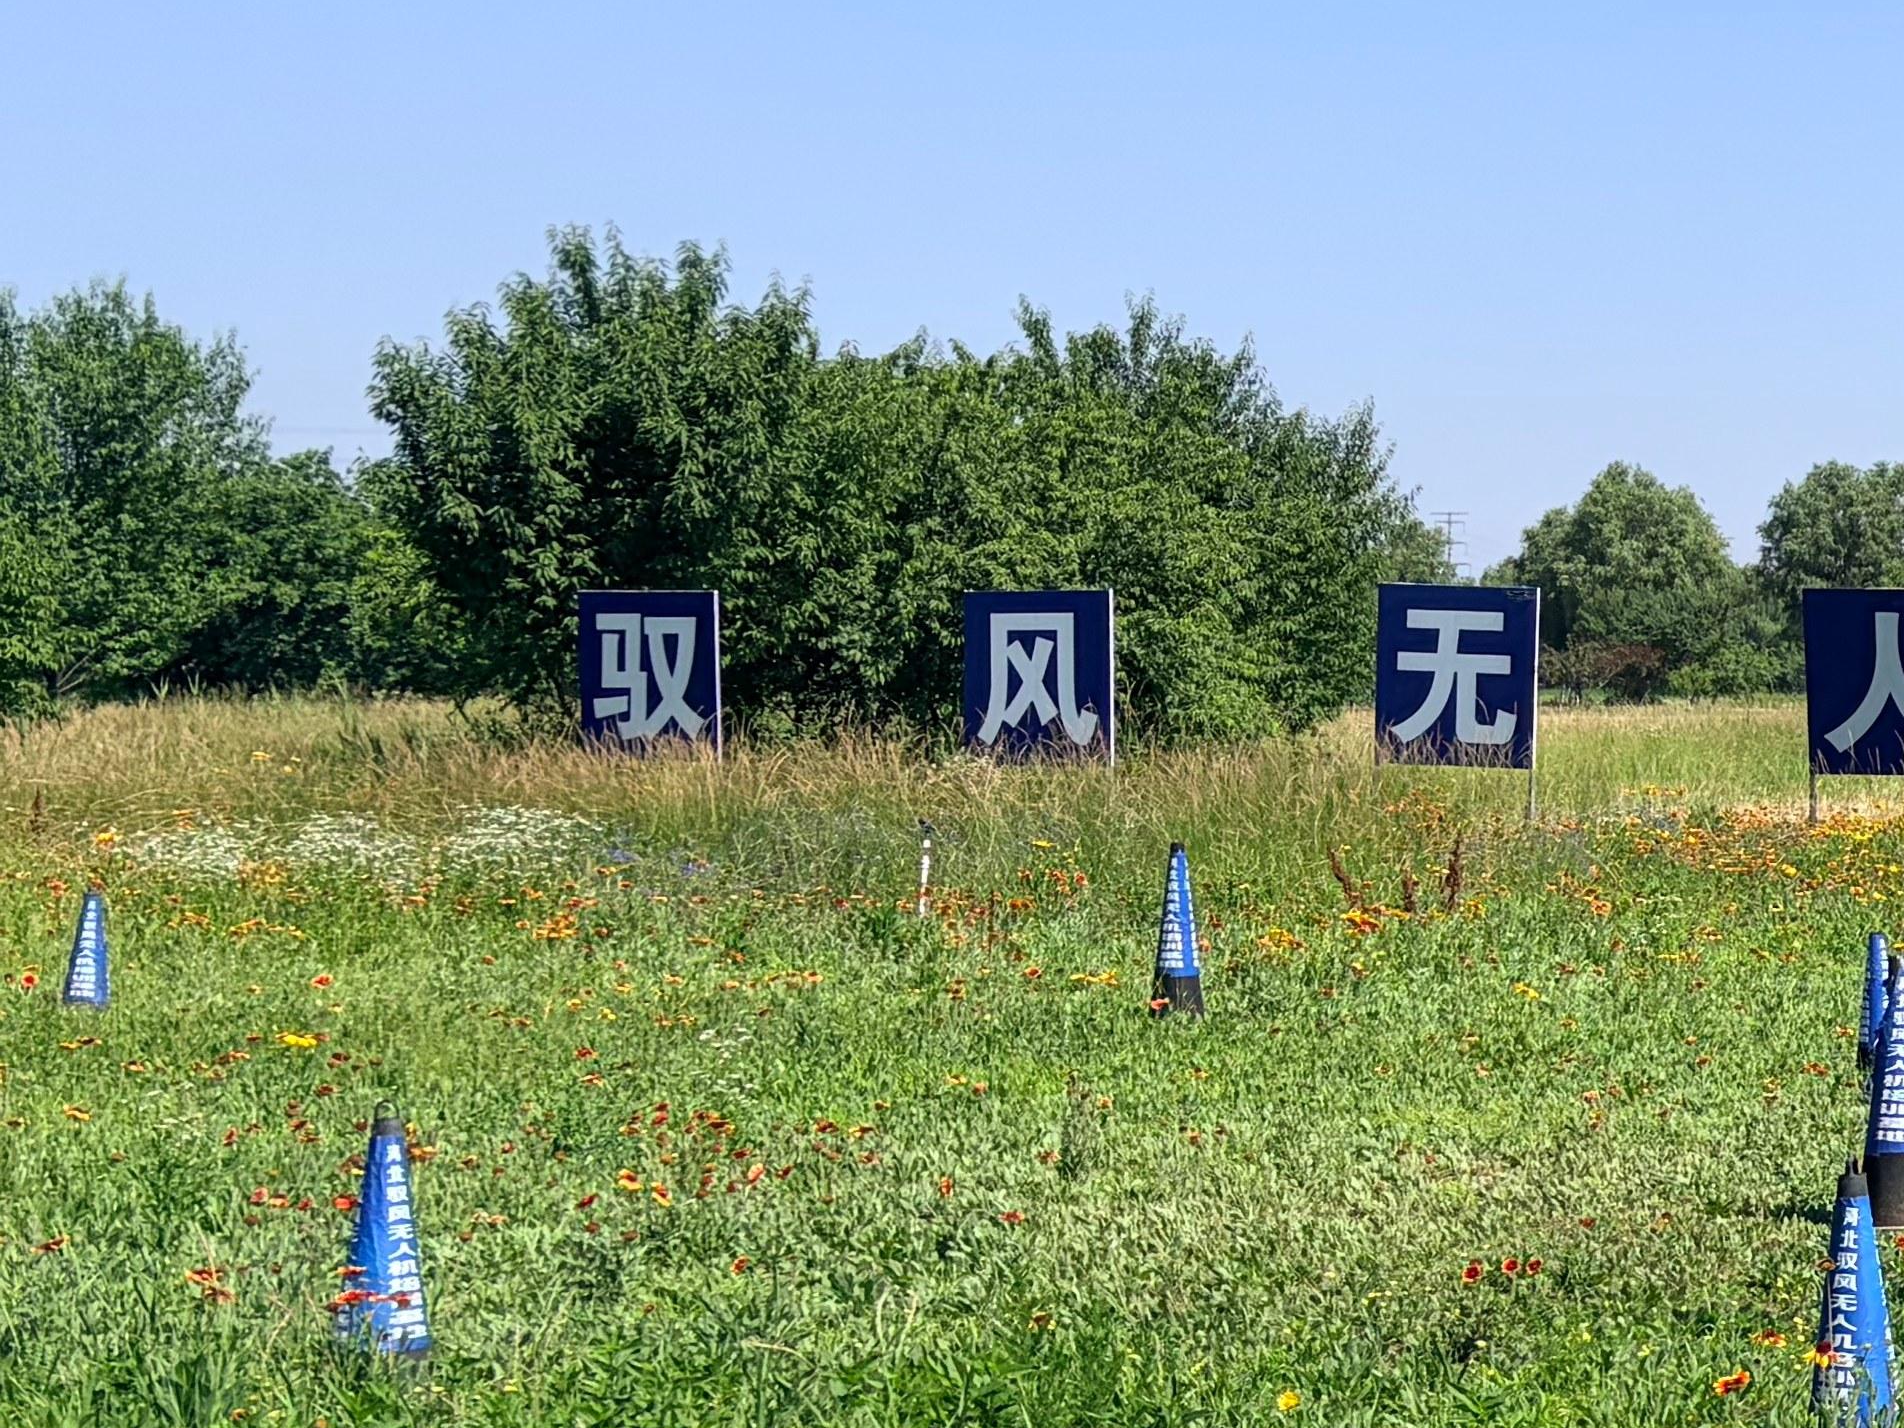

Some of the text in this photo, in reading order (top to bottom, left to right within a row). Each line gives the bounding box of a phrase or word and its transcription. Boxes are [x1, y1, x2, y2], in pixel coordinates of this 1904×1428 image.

[594, 614, 704, 743] 驭
[978, 613, 1098, 745] 风
[1390, 609, 1517, 745] 无
